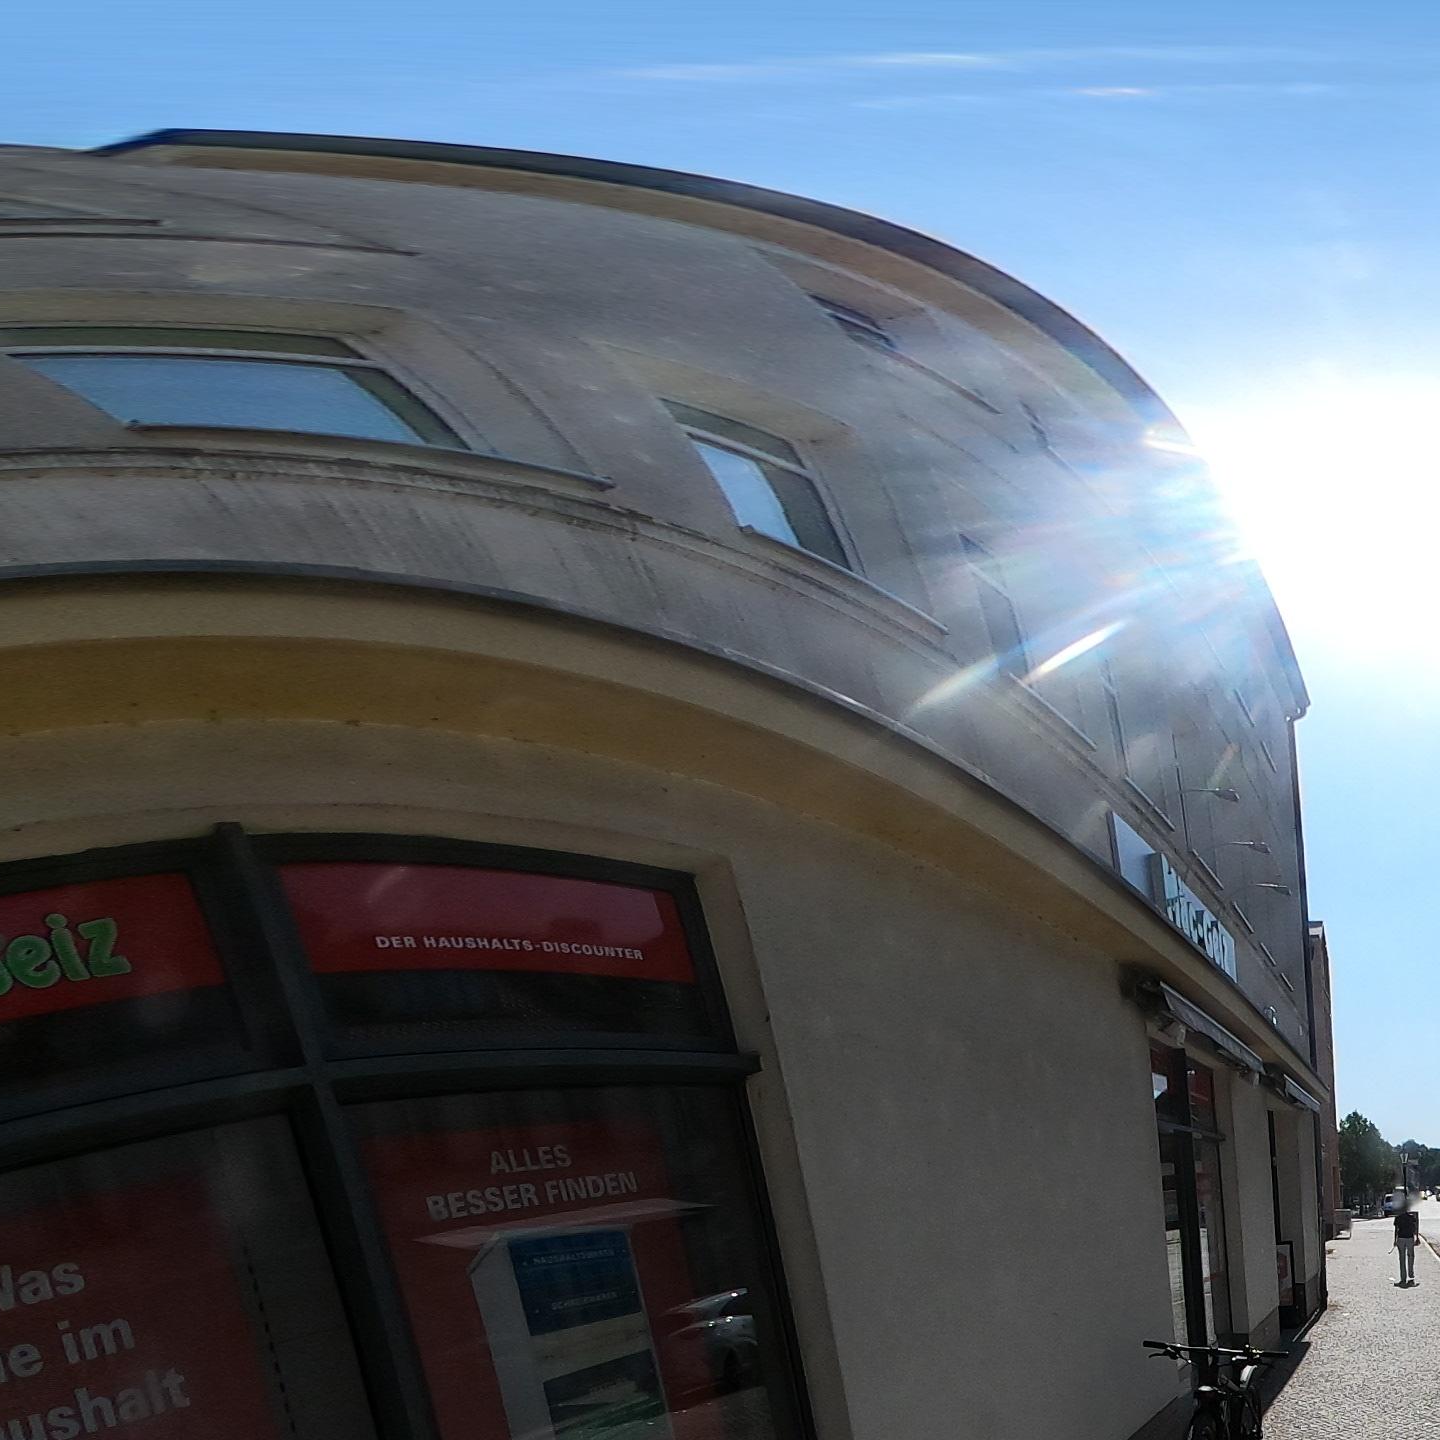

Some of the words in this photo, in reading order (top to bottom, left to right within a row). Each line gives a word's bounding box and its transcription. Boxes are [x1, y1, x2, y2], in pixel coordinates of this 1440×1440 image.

[375, 935, 417, 949] DER
[424, 935, 645, 961] HAUSHALTS-DISCOUNTER
[490, 1144, 572, 1175] ALLES
[425, 1182, 540, 1222] BESSER
[545, 1171, 639, 1205] FINDEN
[55, 1317, 136, 1365] im
